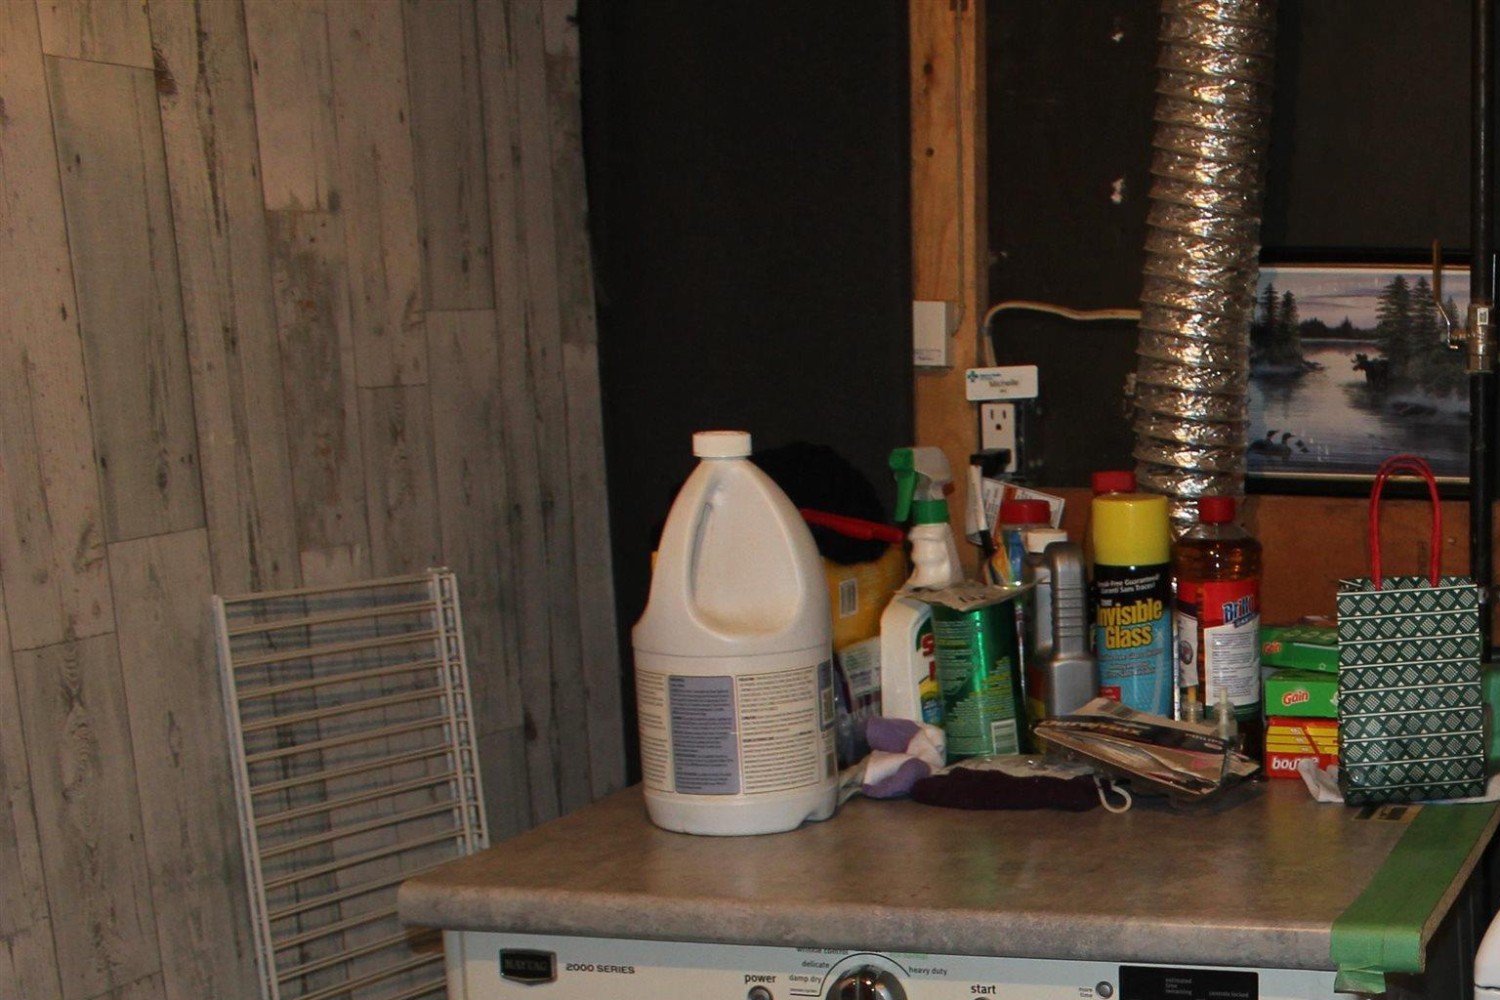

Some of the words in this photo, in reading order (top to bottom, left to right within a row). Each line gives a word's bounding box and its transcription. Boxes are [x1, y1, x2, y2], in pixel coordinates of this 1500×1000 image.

[1097, 598, 1163, 626] Invisible
[1105, 625, 1153, 649] Glass
[1282, 689, 1309, 707] Gain
[504, 959, 548, 971] MAYTAG
[566, 963, 594, 972] 2000
[597, 964, 635, 974] SERIES
[802, 960, 829, 969] delicate
[909, 966, 930, 976] heavy
[932, 967, 947, 976] duty
[745, 973, 777, 984] power
[789, 974, 809, 983] damp
[810, 975, 822, 984] dry
[971, 984, 996, 994] start
